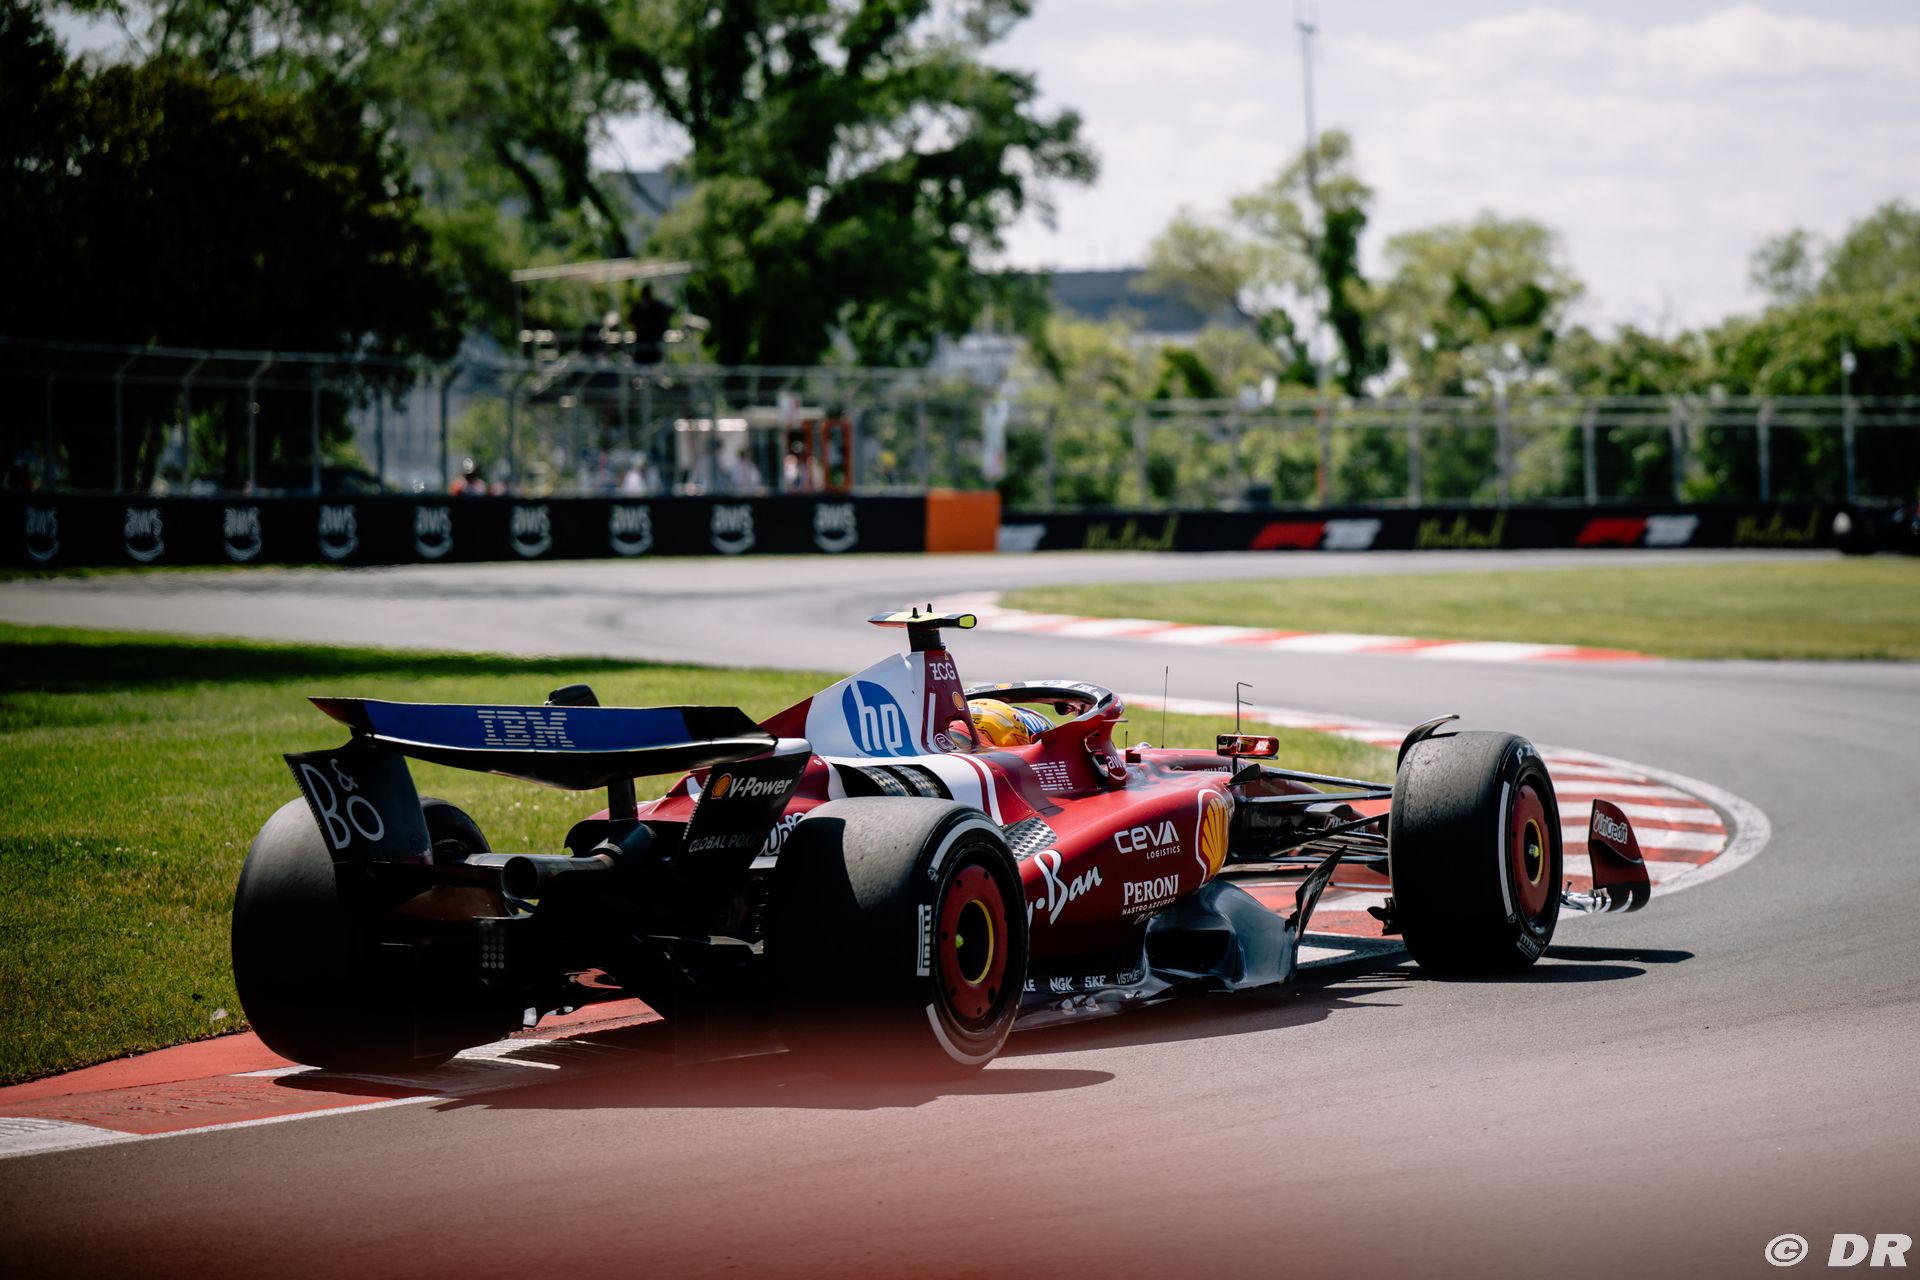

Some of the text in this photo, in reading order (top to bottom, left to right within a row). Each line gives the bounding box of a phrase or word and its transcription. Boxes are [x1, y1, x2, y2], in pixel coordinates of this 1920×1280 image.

[477, 709, 576, 748] IBM
[849, 682, 904, 757] hp
[1105, 754, 1126, 771] aw
[728, 776, 793, 798] V-Power
[1029, 761, 1074, 791] IBM
[1146, 845, 1181, 860] LOGISTICS
[1123, 874, 1179, 906] PERONI
[1121, 905, 1148, 916] NASTRO
[916, 903, 933, 977] PIRELLI
[1049, 977, 1074, 992] NGK
[1084, 975, 1107, 989] SKF
